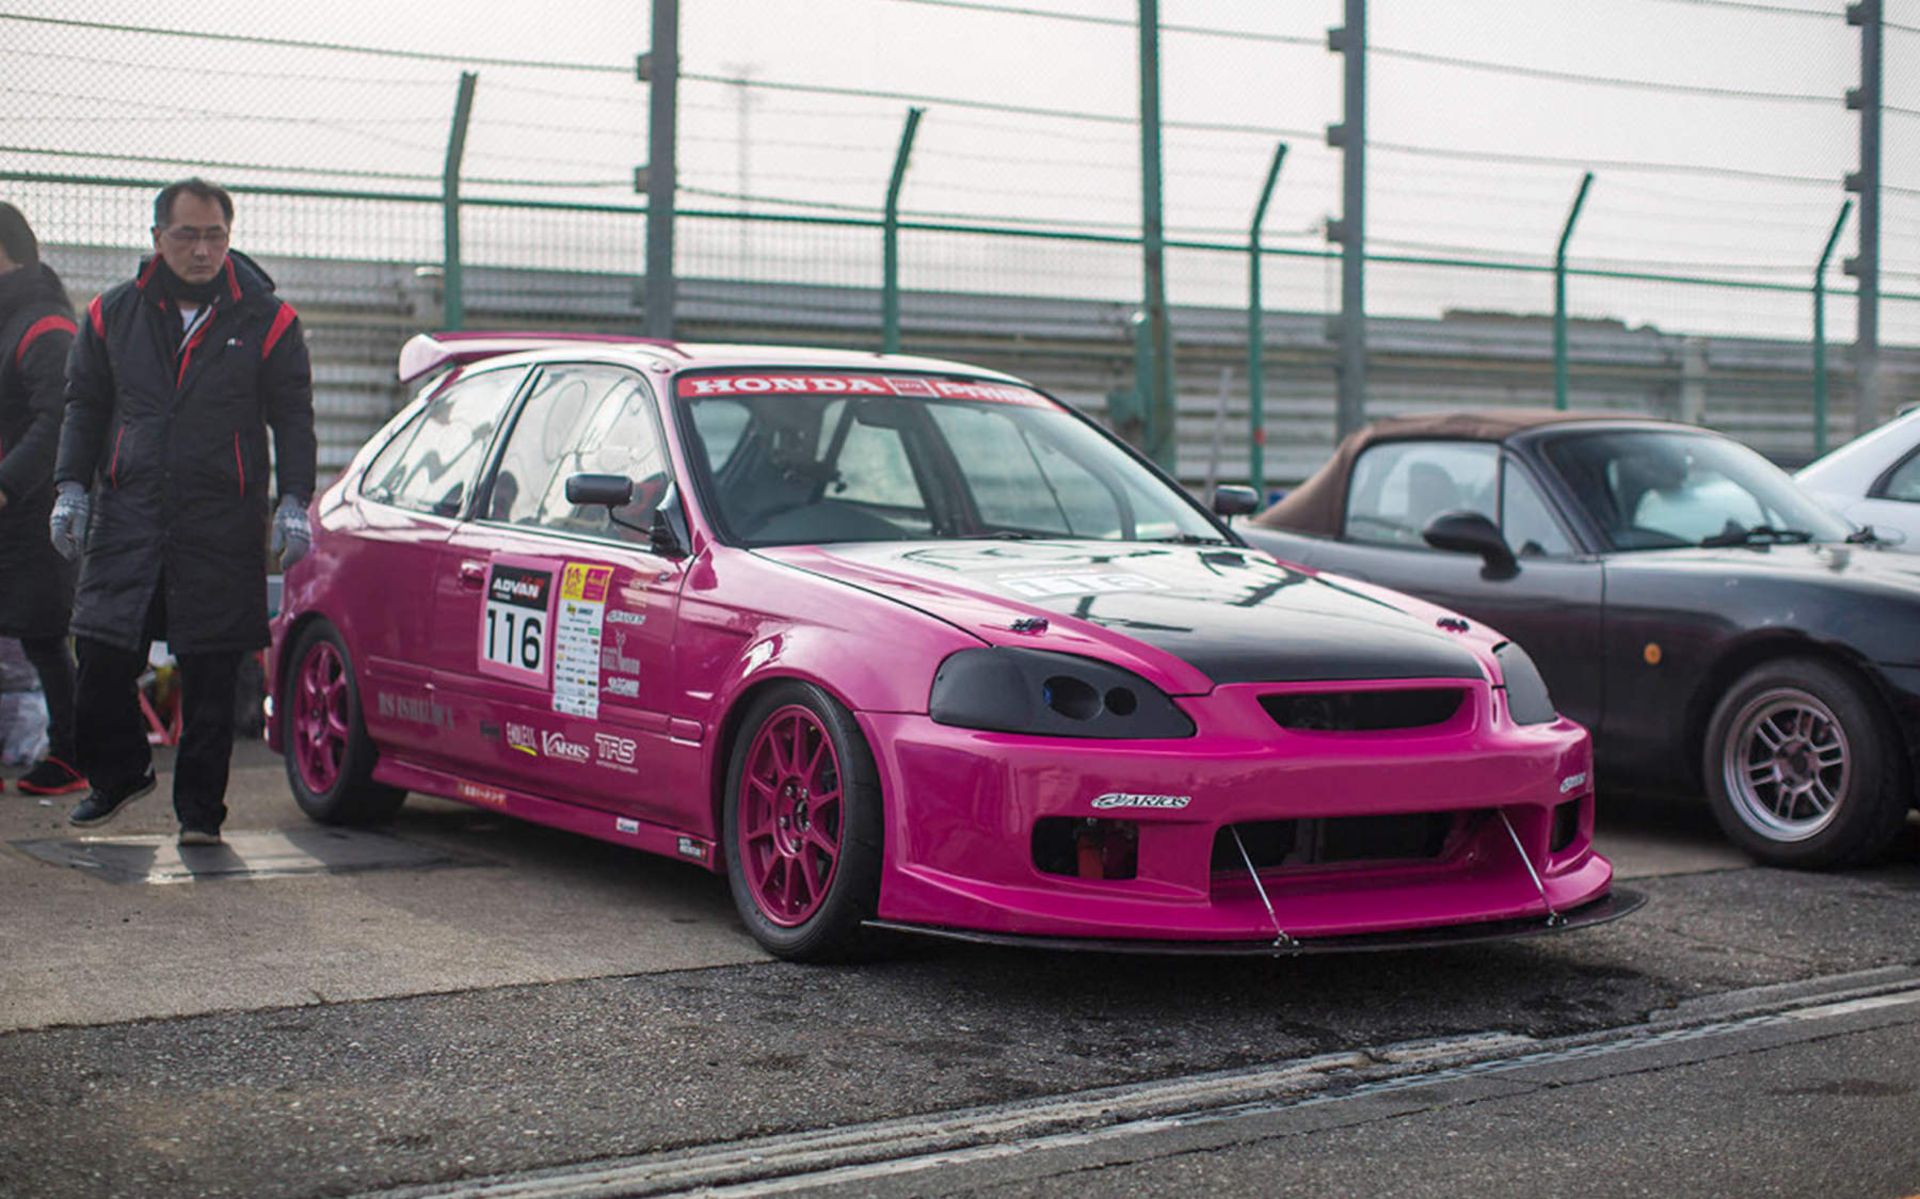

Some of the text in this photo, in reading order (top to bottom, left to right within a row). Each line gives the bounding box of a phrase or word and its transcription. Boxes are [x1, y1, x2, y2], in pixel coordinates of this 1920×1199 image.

[692, 377, 885, 394] HONDA
[493, 577, 540, 598] ADVAN
[487, 609, 541, 669] 116
[595, 732, 638, 764] TRS
